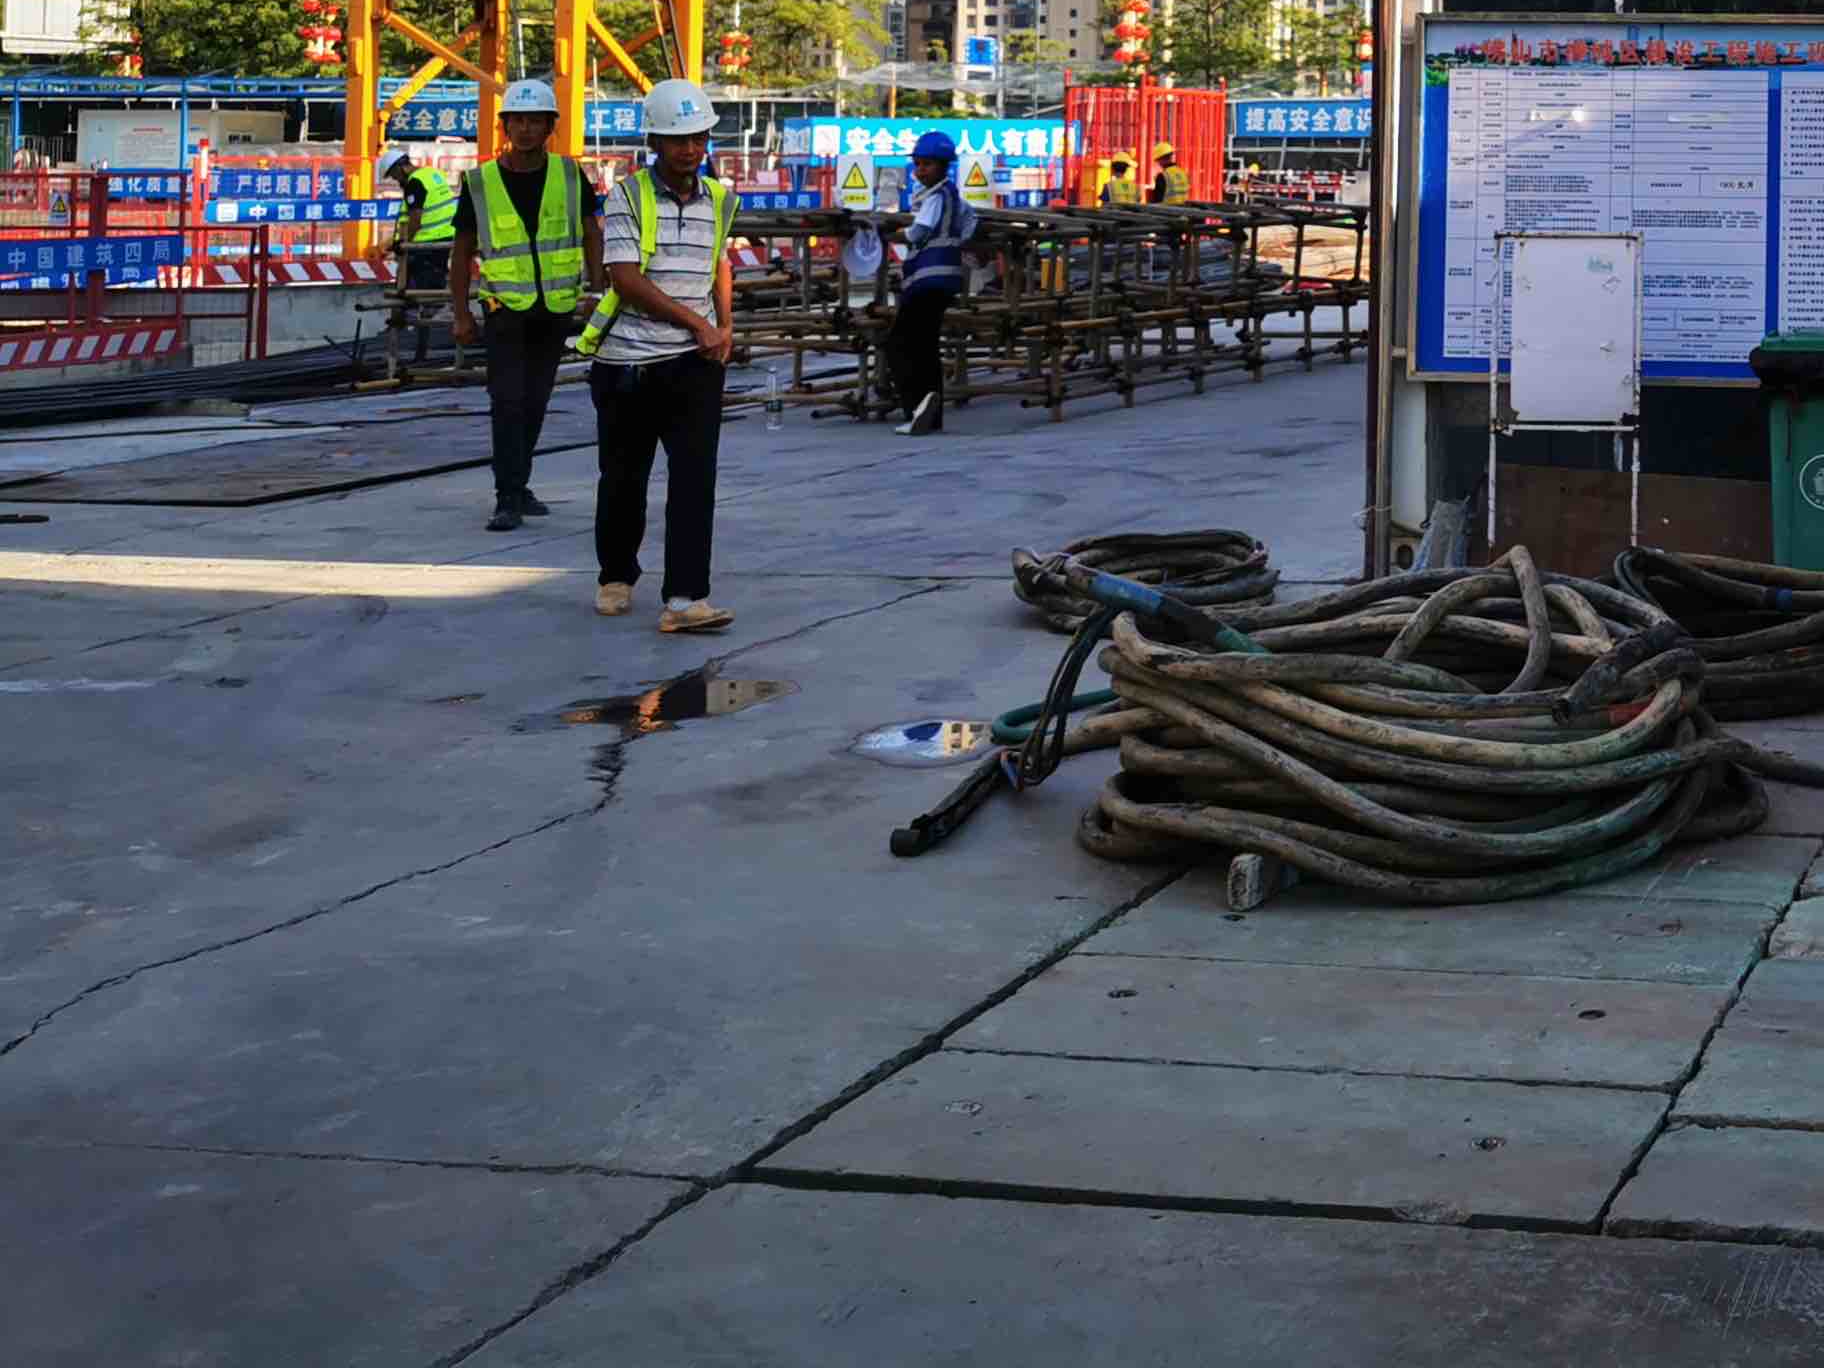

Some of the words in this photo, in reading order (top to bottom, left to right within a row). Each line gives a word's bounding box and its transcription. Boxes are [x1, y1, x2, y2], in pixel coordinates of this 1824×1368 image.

[1246, 107, 1372, 133] 提高安全意识
[7, 239, 171, 272] 中国建筑四局
